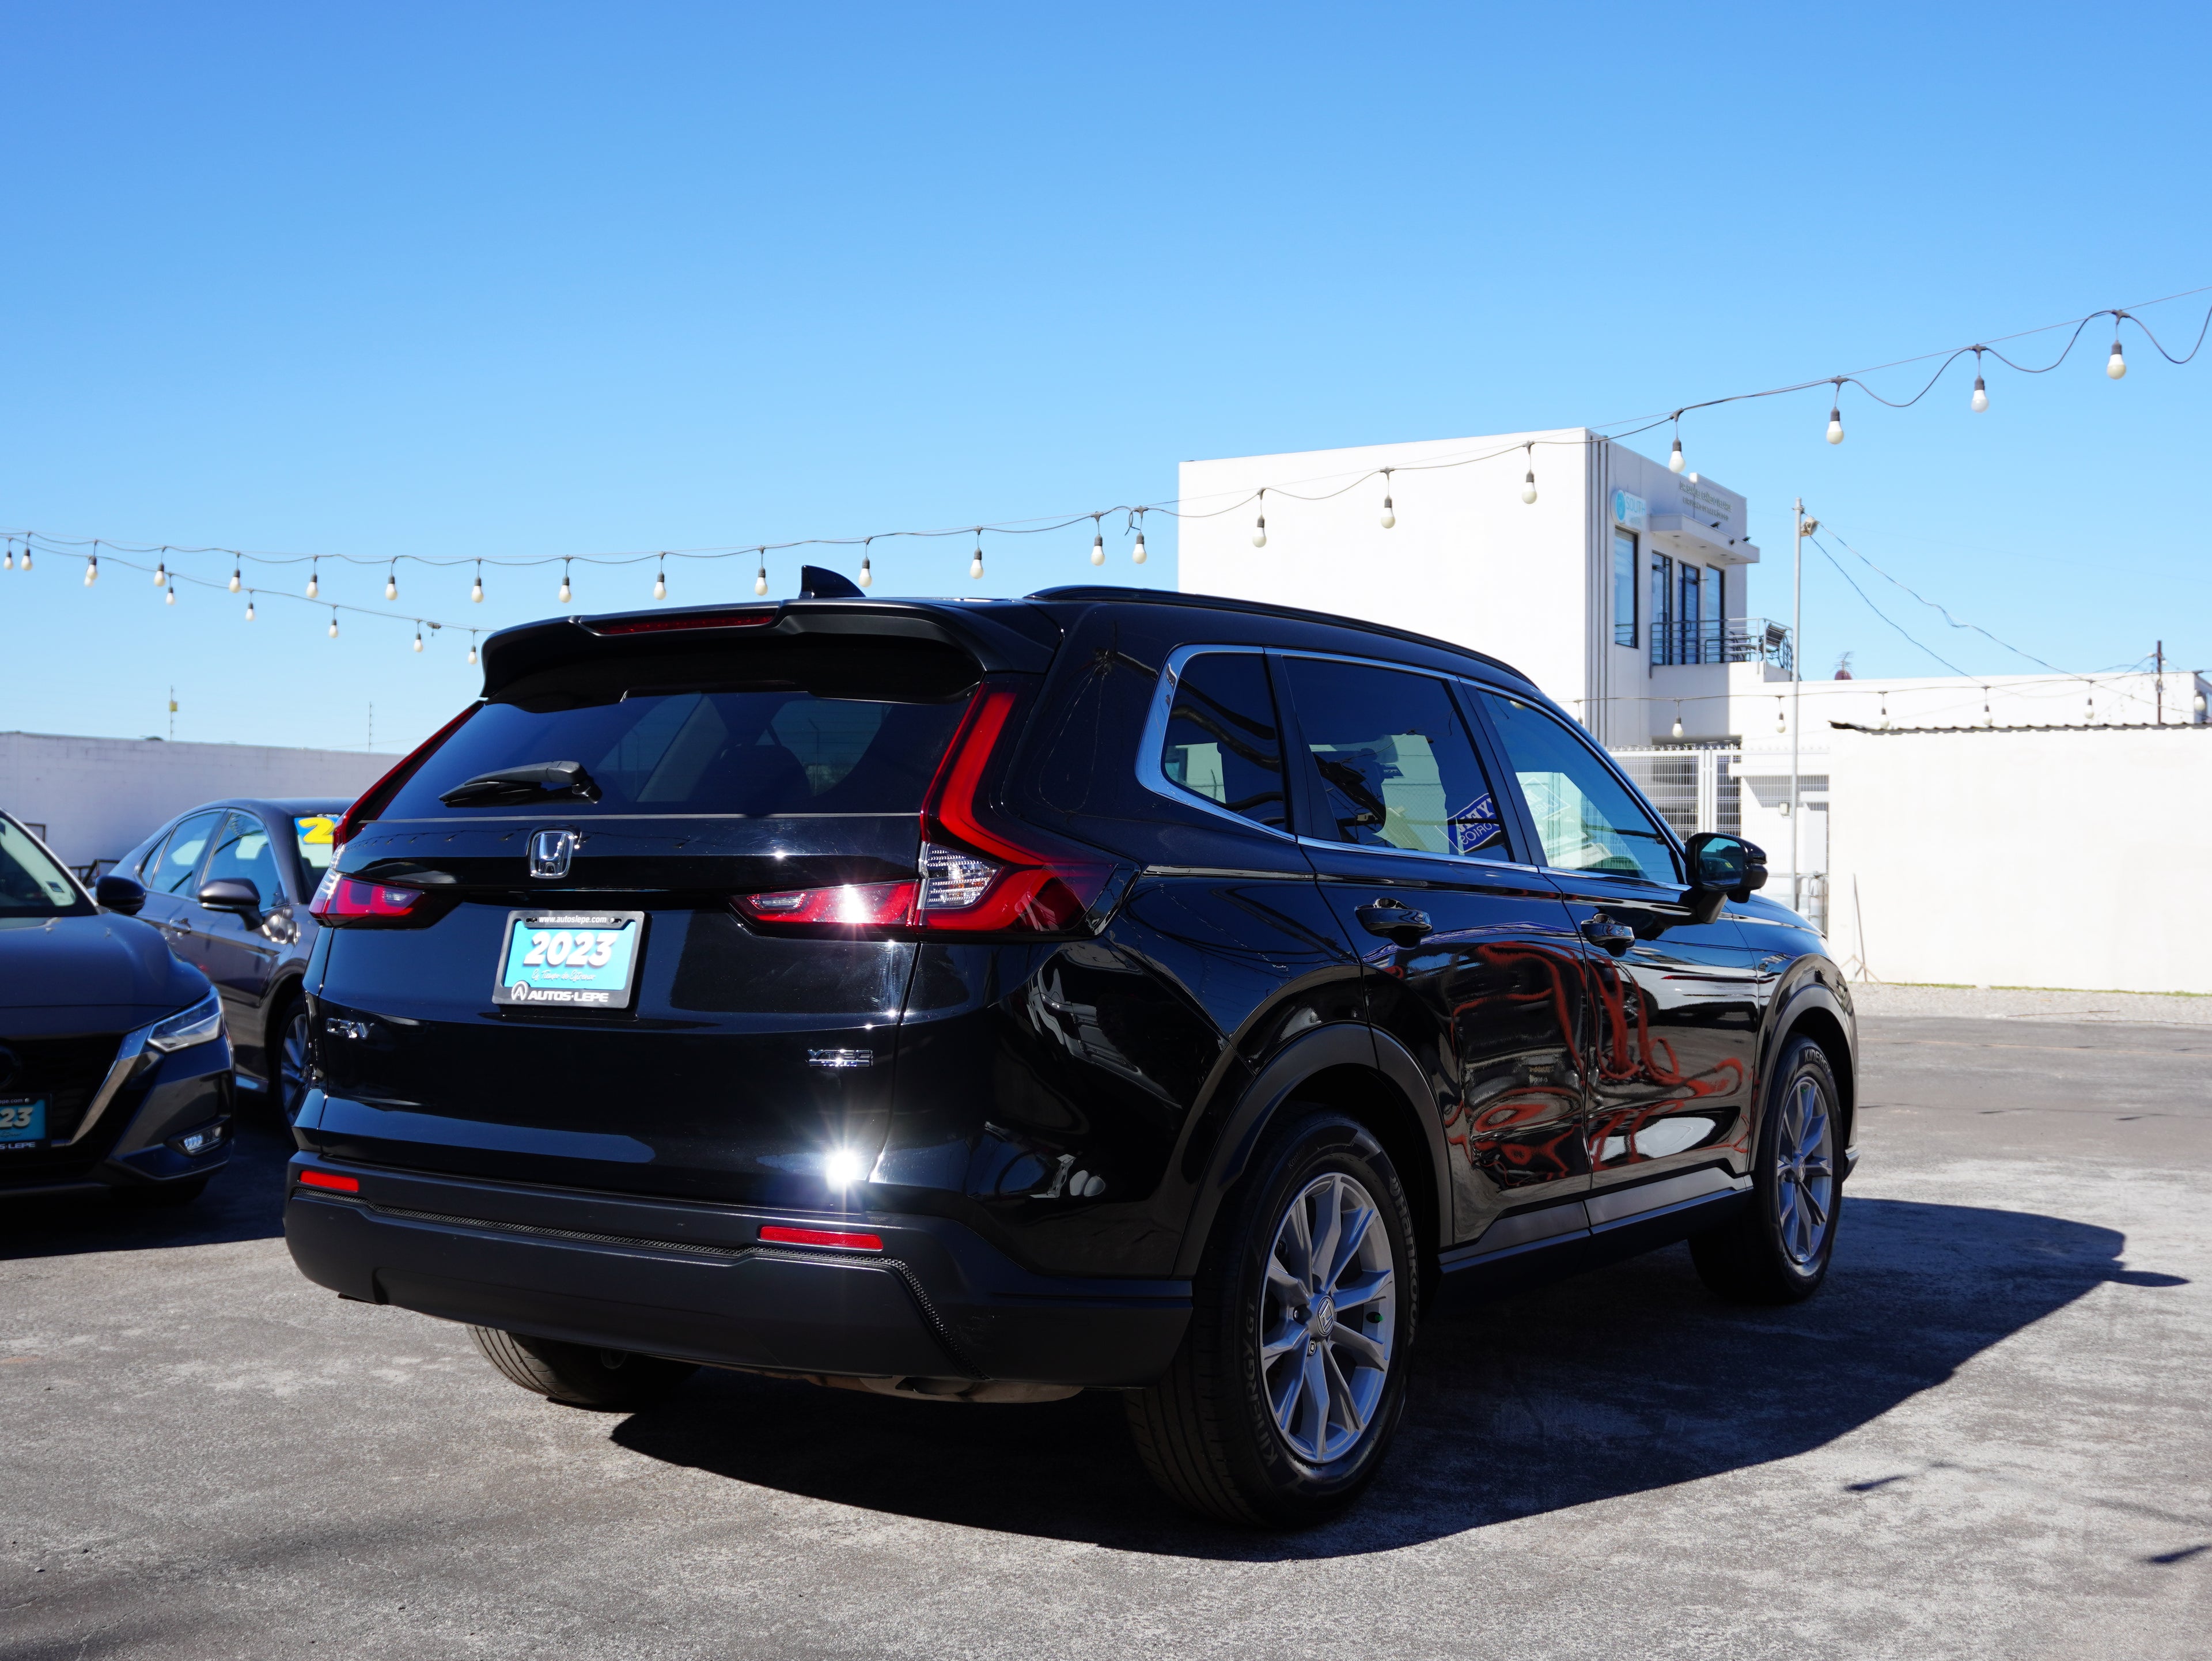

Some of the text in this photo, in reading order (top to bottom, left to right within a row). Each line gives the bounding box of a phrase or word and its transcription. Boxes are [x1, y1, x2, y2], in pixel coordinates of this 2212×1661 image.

[1626, 495, 1646, 516] SOUTH
[539, 915, 607, 924] www.autoslepe.com
[523, 931, 619, 967] 2023
